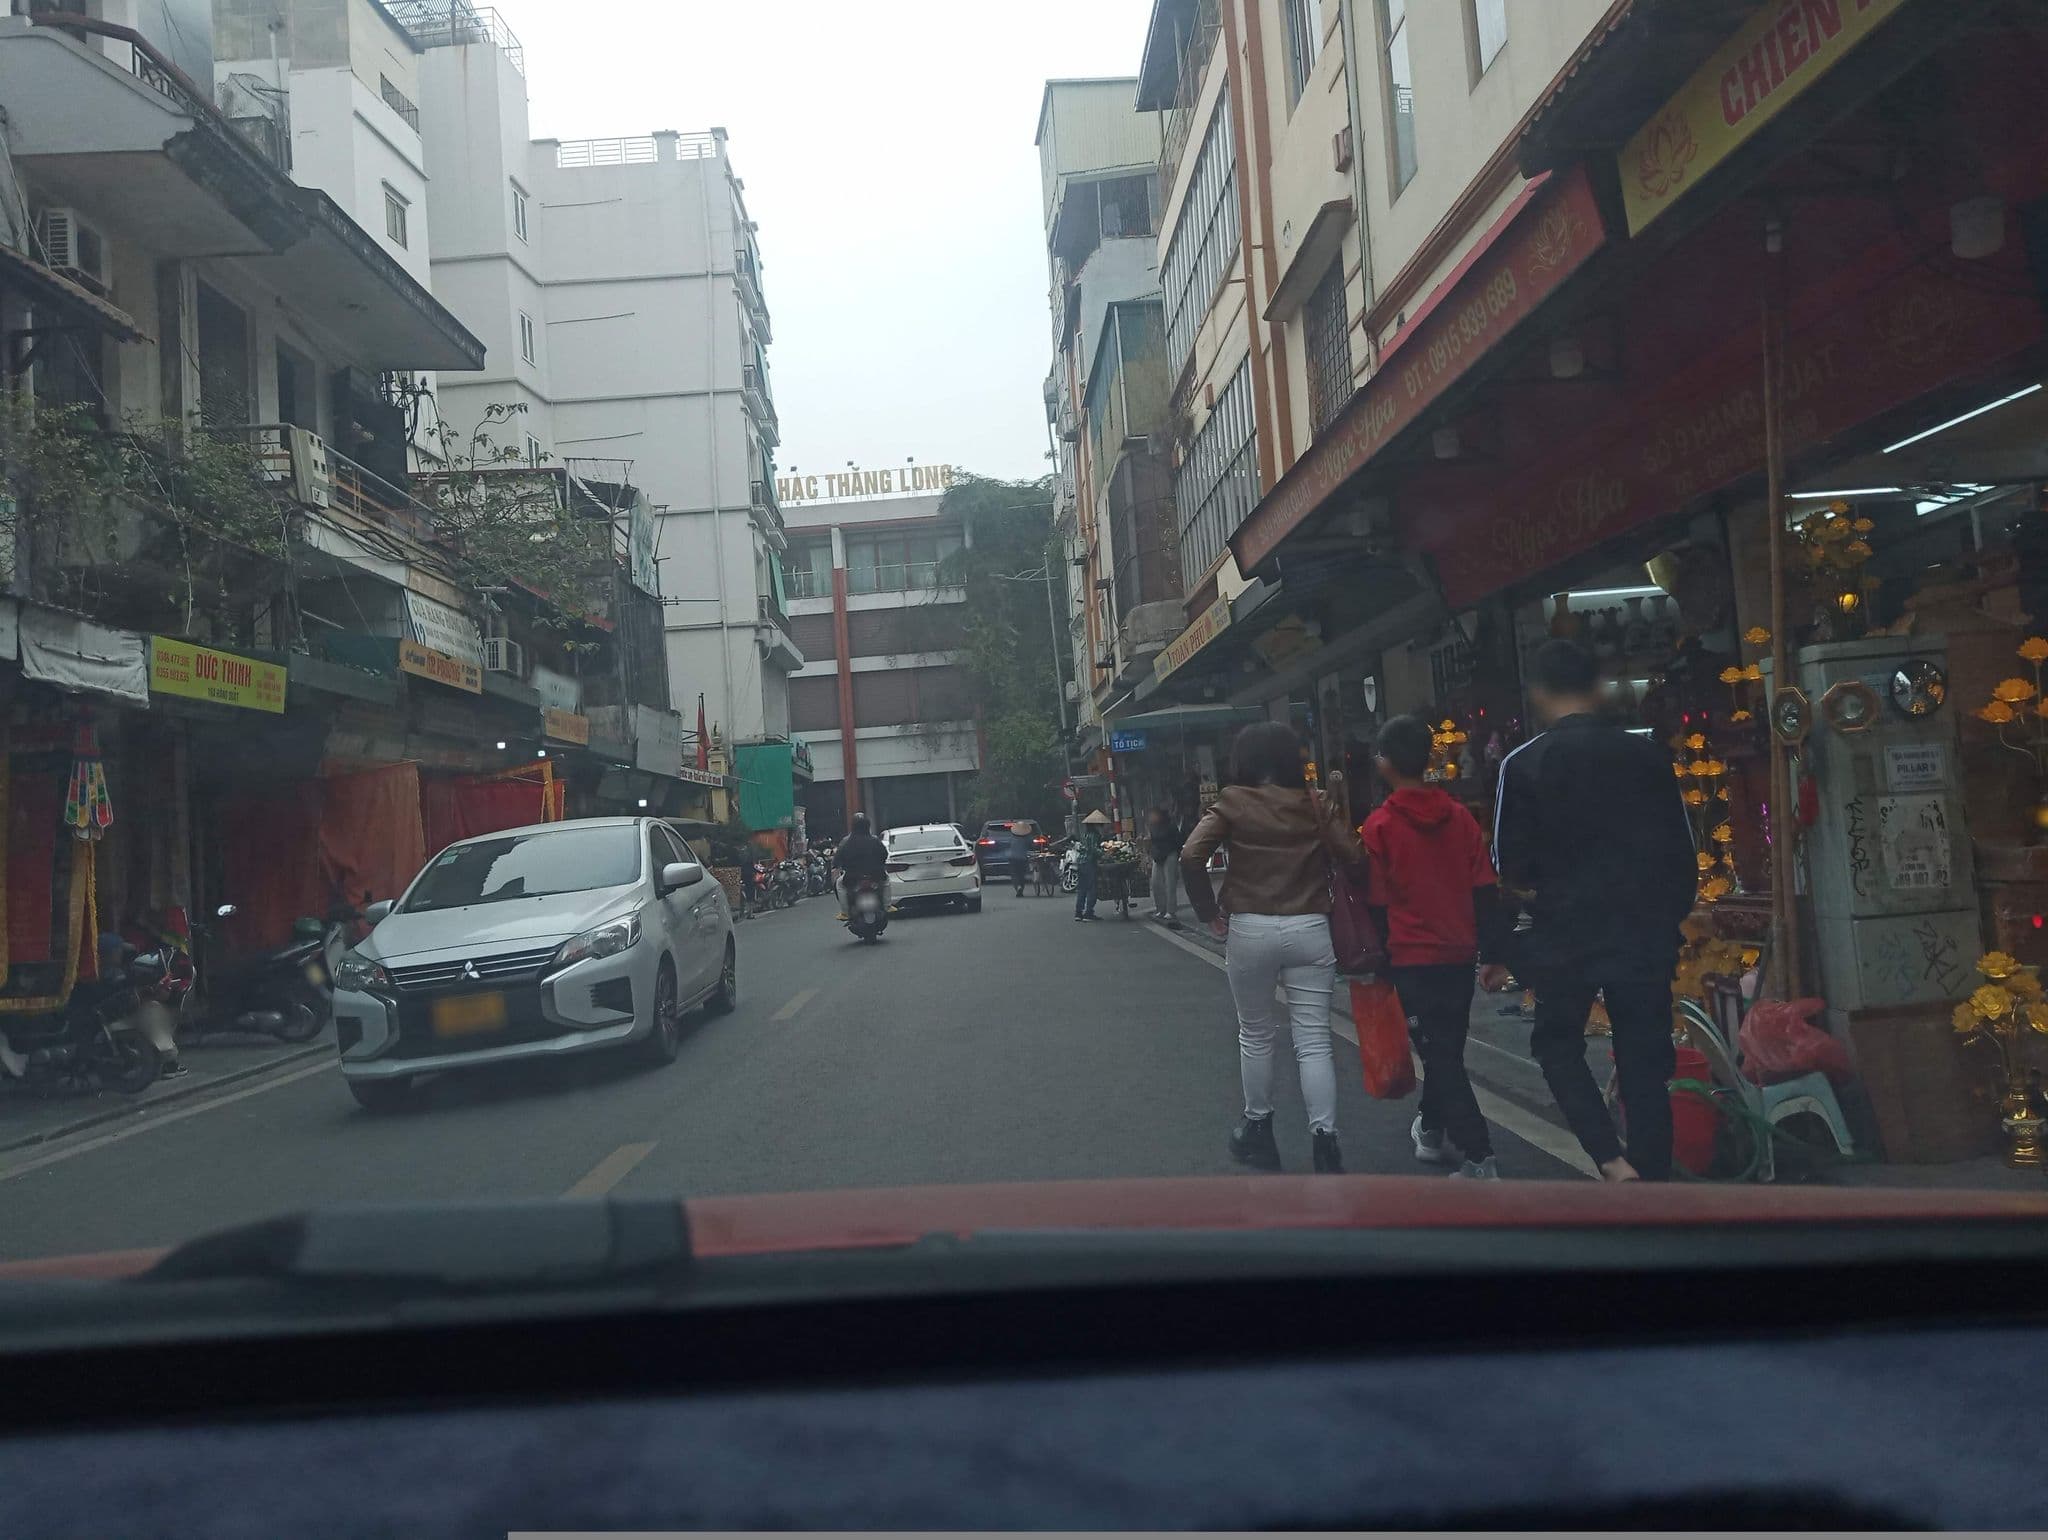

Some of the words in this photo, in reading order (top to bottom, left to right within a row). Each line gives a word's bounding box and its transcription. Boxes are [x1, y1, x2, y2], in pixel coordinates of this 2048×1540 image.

[1428, 323, 1461, 375] 0915
[1459, 297, 1488, 345] 939
[1486, 267, 1517, 317] 689
[825, 465, 892, 498] THĂNG
[899, 464, 951, 492] LONG
[195, 650, 218, 681] ĐỨC
[1896, 762, 1930, 774] PILLAR
